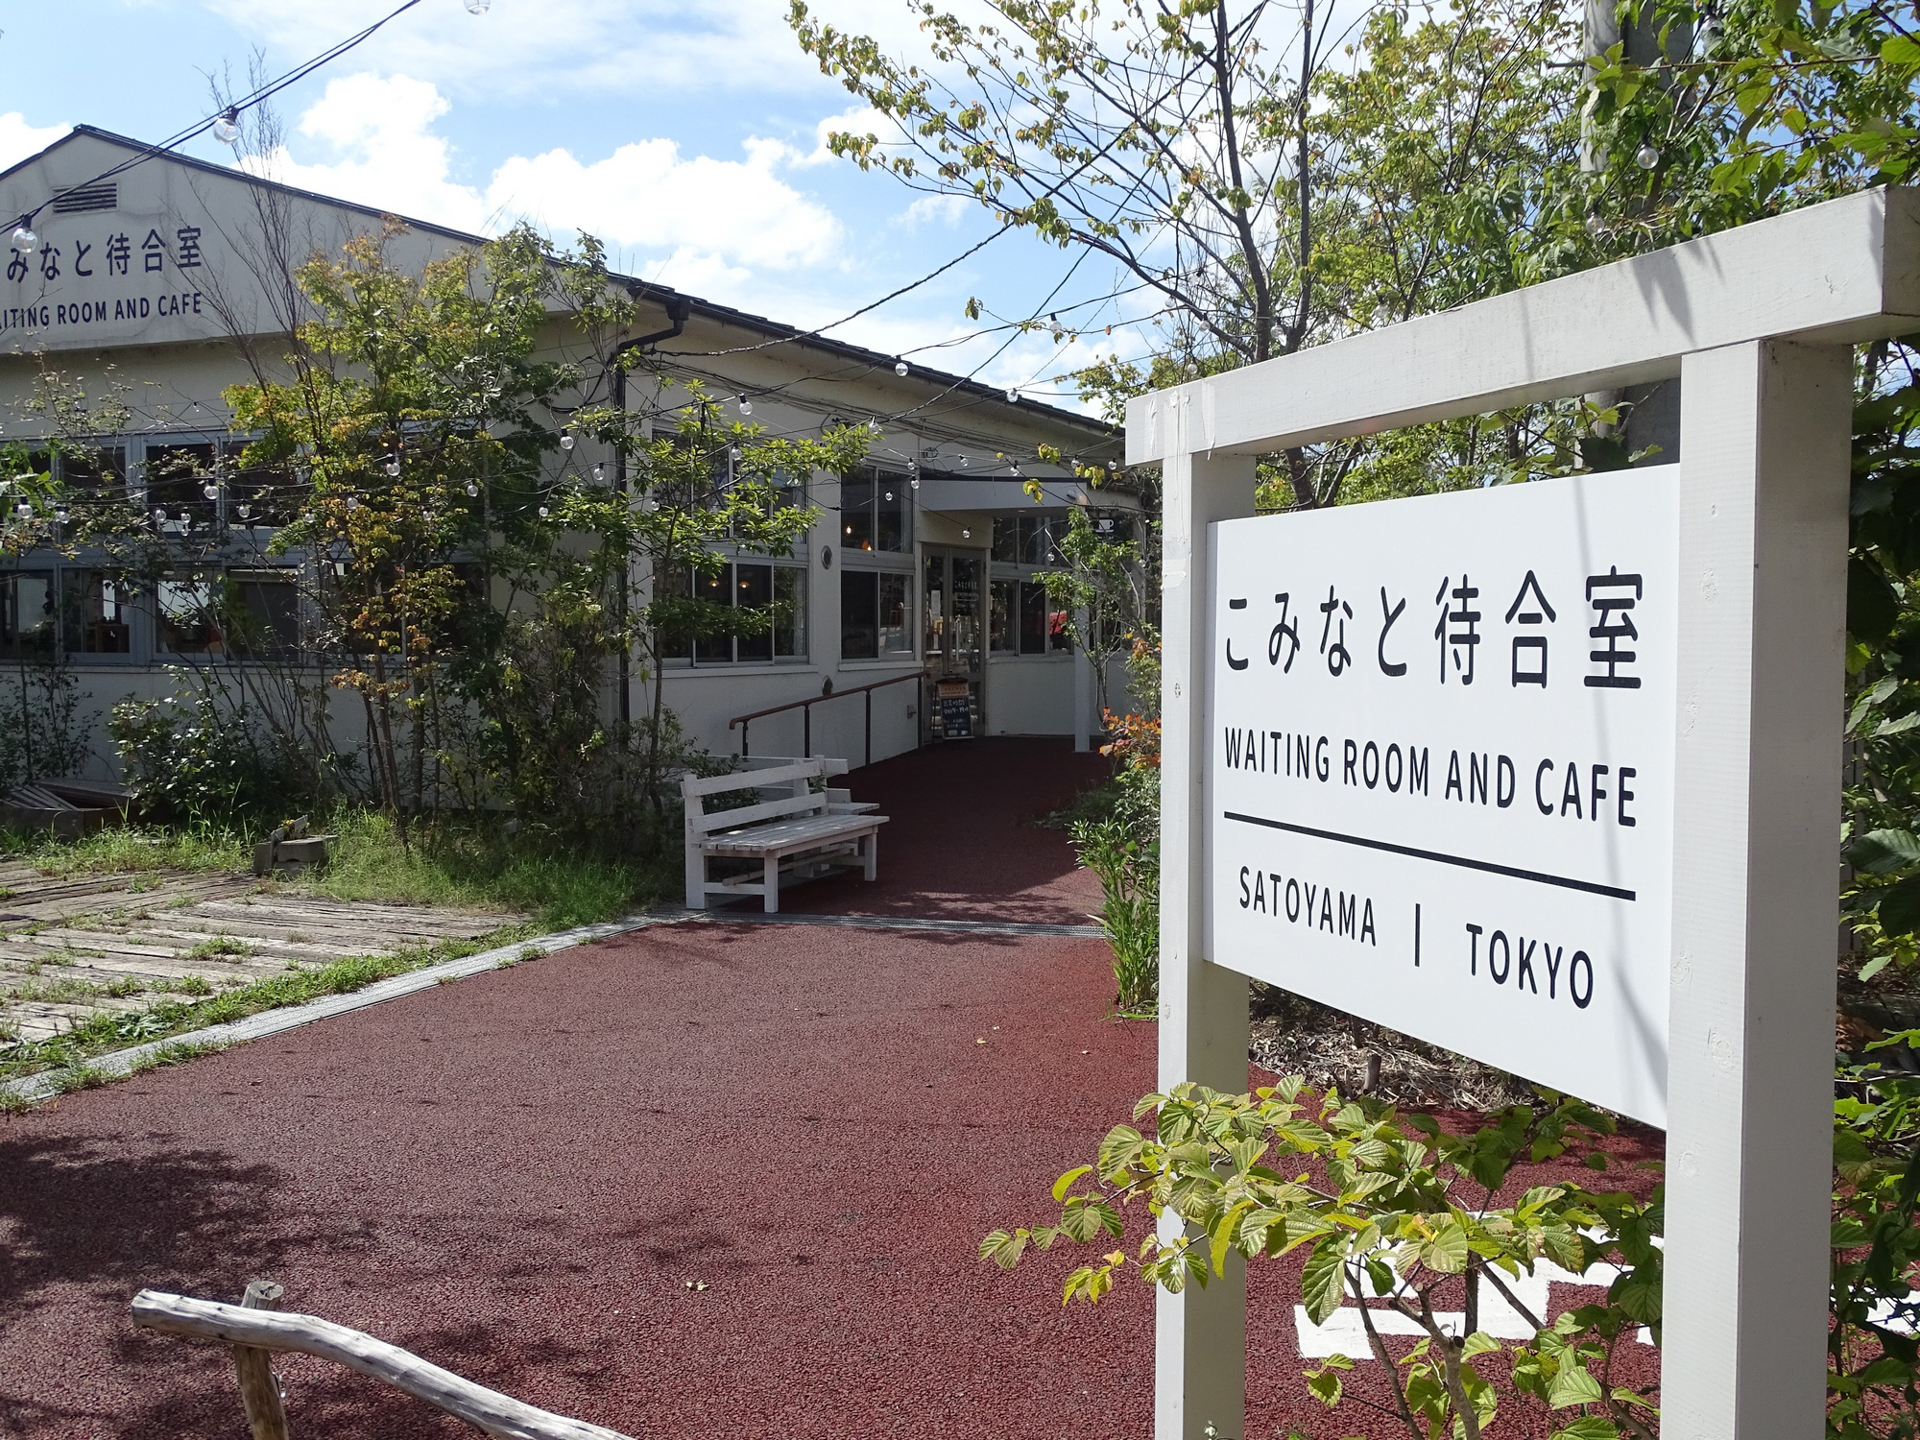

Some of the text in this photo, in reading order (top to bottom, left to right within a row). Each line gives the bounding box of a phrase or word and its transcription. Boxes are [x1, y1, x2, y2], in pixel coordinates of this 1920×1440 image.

[0, 292, 202, 330] ITING ROOM AND CAFE
[1226, 565, 1643, 689] こみなと待合室
[1225, 727, 1637, 828] WAITING ROOM AND CAFE
[1239, 866, 1594, 1009] SATOYAMA TOKYO
